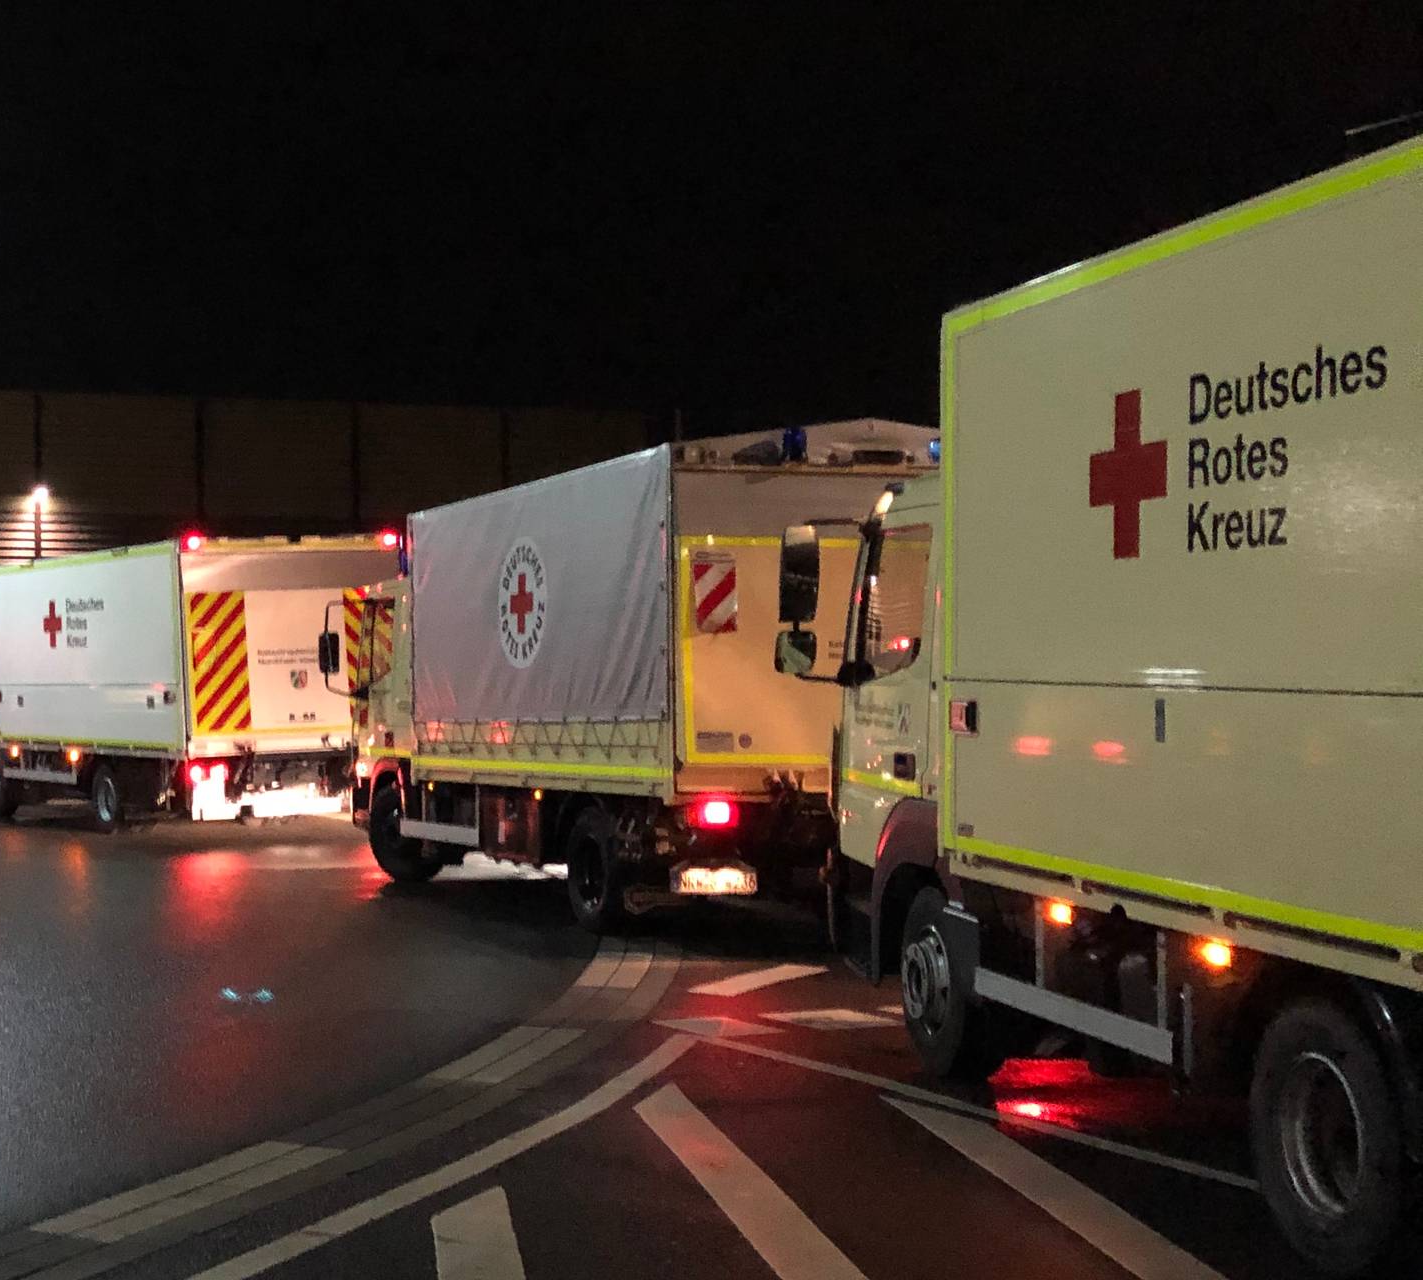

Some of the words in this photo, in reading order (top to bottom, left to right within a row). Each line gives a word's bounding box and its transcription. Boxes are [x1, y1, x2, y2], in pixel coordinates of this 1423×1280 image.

[1189, 344, 1388, 425] Deutsches
[1188, 434, 1289, 489] Rotes
[1187, 503, 1288, 553] Kreuz
[65, 597, 105, 613] Deutsches
[66, 616, 88, 631] Rotes
[66, 635, 89, 649] Kreuz
